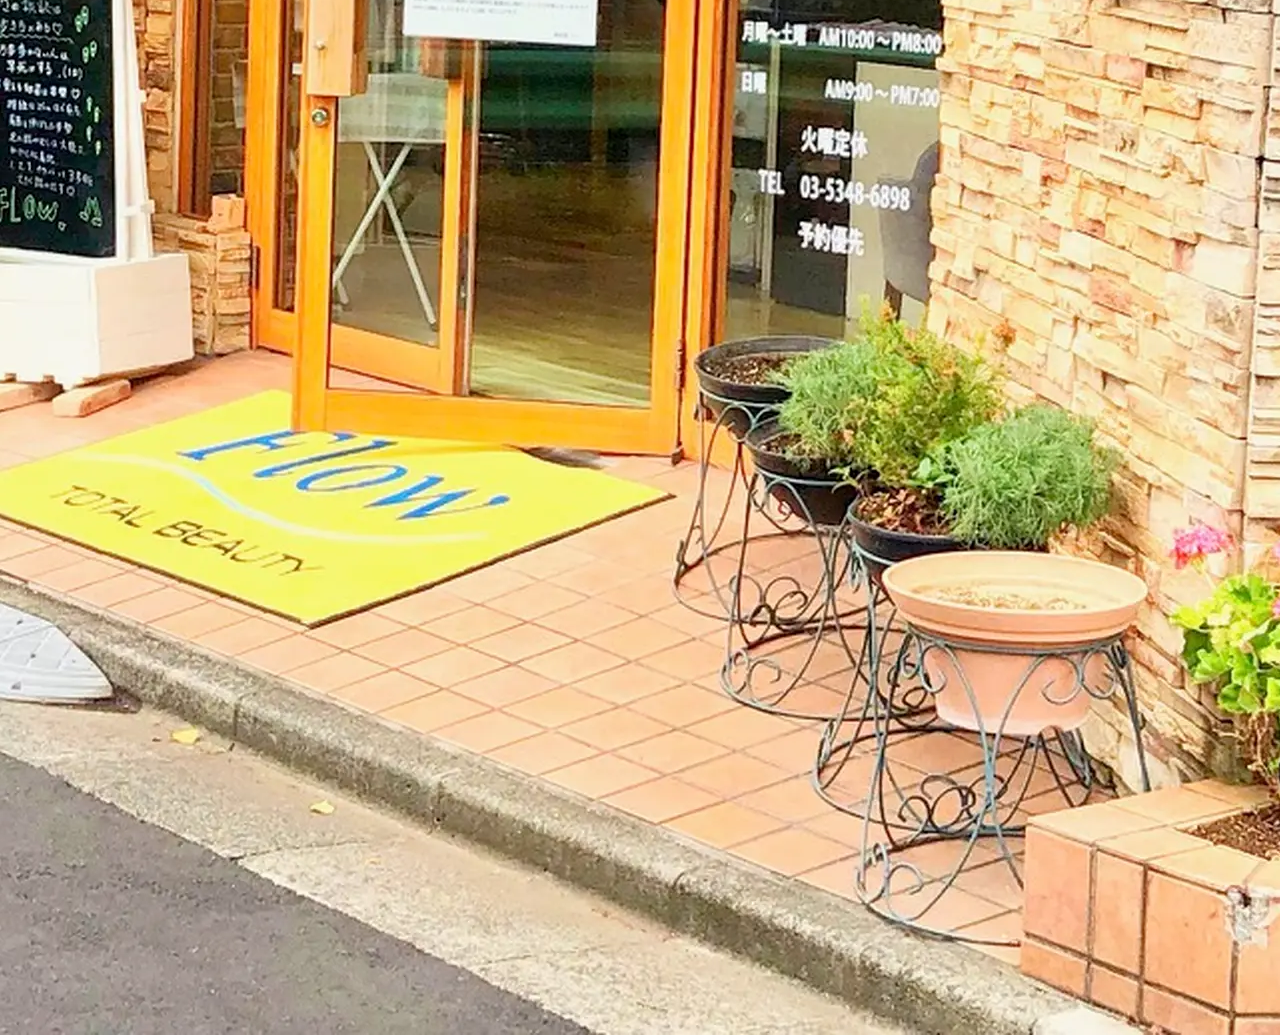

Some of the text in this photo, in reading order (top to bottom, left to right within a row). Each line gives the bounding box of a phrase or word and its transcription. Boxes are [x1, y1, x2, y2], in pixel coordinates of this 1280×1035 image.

[741, 71, 767, 94] 日曜
[800, 126, 869, 159] 火曜定休
[758, 169, 911, 211] TEL 03-5348-6898
[797, 221, 865, 255] 予約優先
[177, 429, 512, 522] Flow
[50, 483, 323, 576] TOTAL BEAUTY
